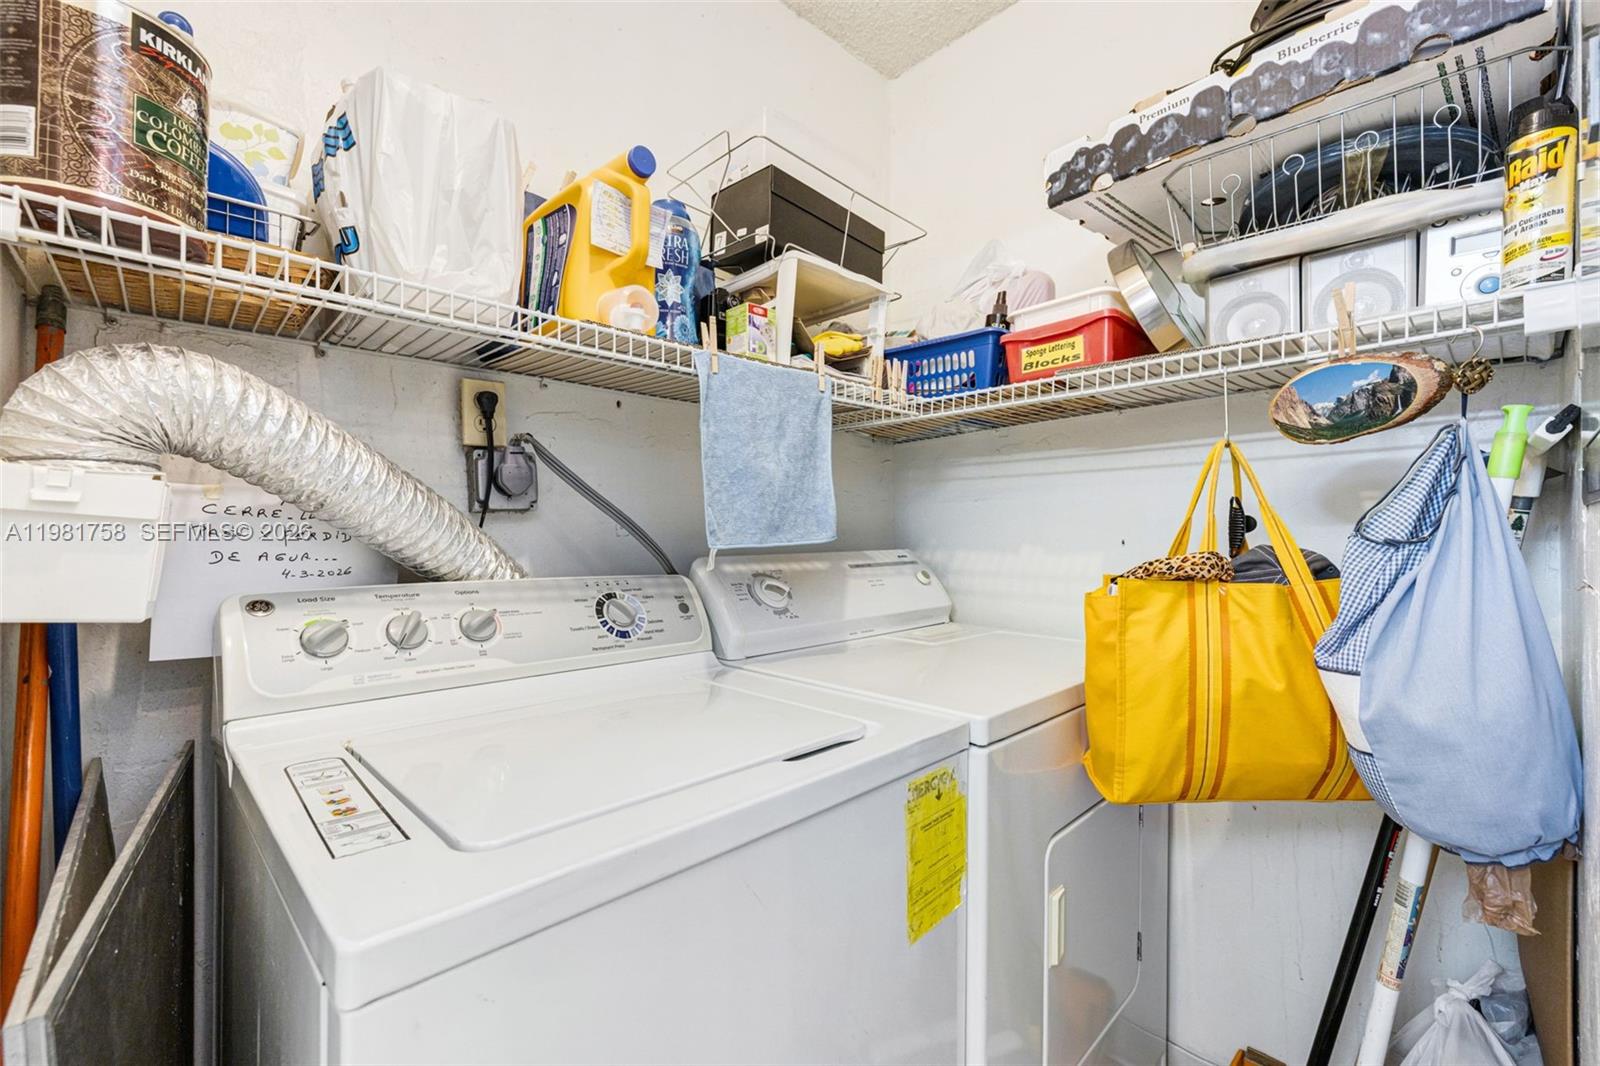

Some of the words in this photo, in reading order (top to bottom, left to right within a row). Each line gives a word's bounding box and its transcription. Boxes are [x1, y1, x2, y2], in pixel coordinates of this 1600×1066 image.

[1277, 20, 1360, 61] Blueberries
[1139, 96, 1190, 124] Premium
[1508, 139, 1566, 191] Raid
[129, 168, 158, 187] Dark
[160, 181, 185, 199] Roast
[161, 202, 168, 211] 3
[1518, 207, 1565, 228] Cucarachas
[1025, 347, 1047, 358] Sponge
[1048, 340, 1076, 352] Lettering
[1023, 352, 1081, 371] Blocks
[208, 550, 241, 564] DE
[281, 566, 352, 579] 4-3-2026
